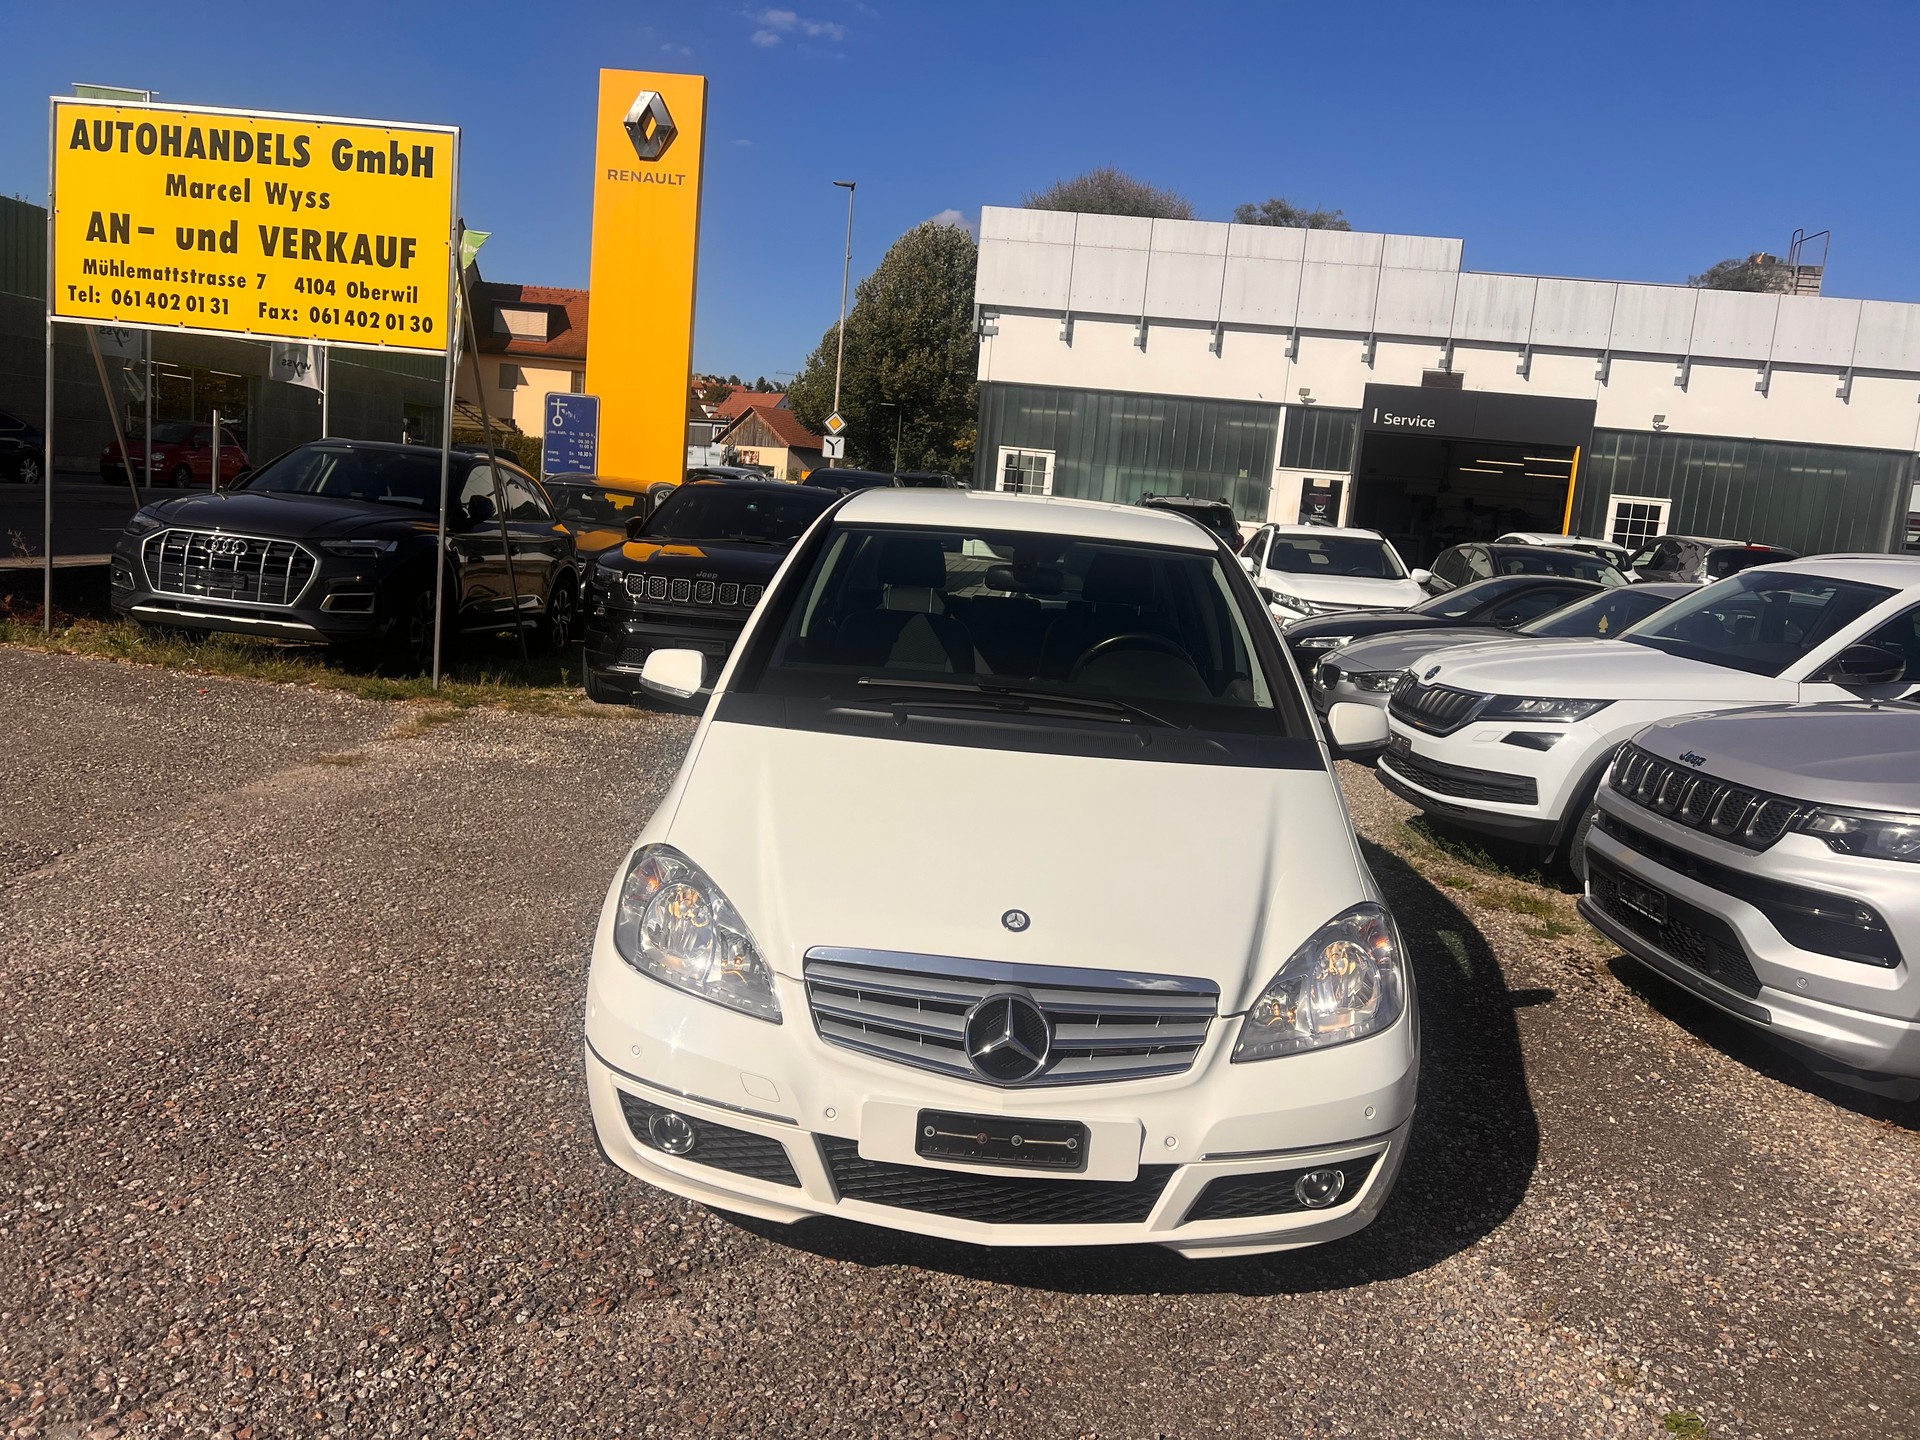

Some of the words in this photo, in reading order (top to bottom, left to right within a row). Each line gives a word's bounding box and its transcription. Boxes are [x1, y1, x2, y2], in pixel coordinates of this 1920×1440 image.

[69, 118, 311, 168] AUTOHANDELS
[331, 138, 434, 179] GmbH
[165, 173, 251, 203] Marcel
[264, 181, 330, 212] Wyss
[607, 169, 686, 186] RENAULT
[175, 219, 239, 254] und
[258, 224, 417, 270] VERKAUF
[82, 258, 247, 289] Mühlemattstrasse
[256, 273, 267, 290] 7
[294, 276, 336, 296] 4104
[346, 281, 418, 304] Oberwil
[67, 284, 101, 304] Tel:
[258, 301, 298, 322] Fax:
[1383, 412, 1436, 428] Service
[696, 570, 718, 580] Jeep
[1679, 750, 1707, 767] Jeep
